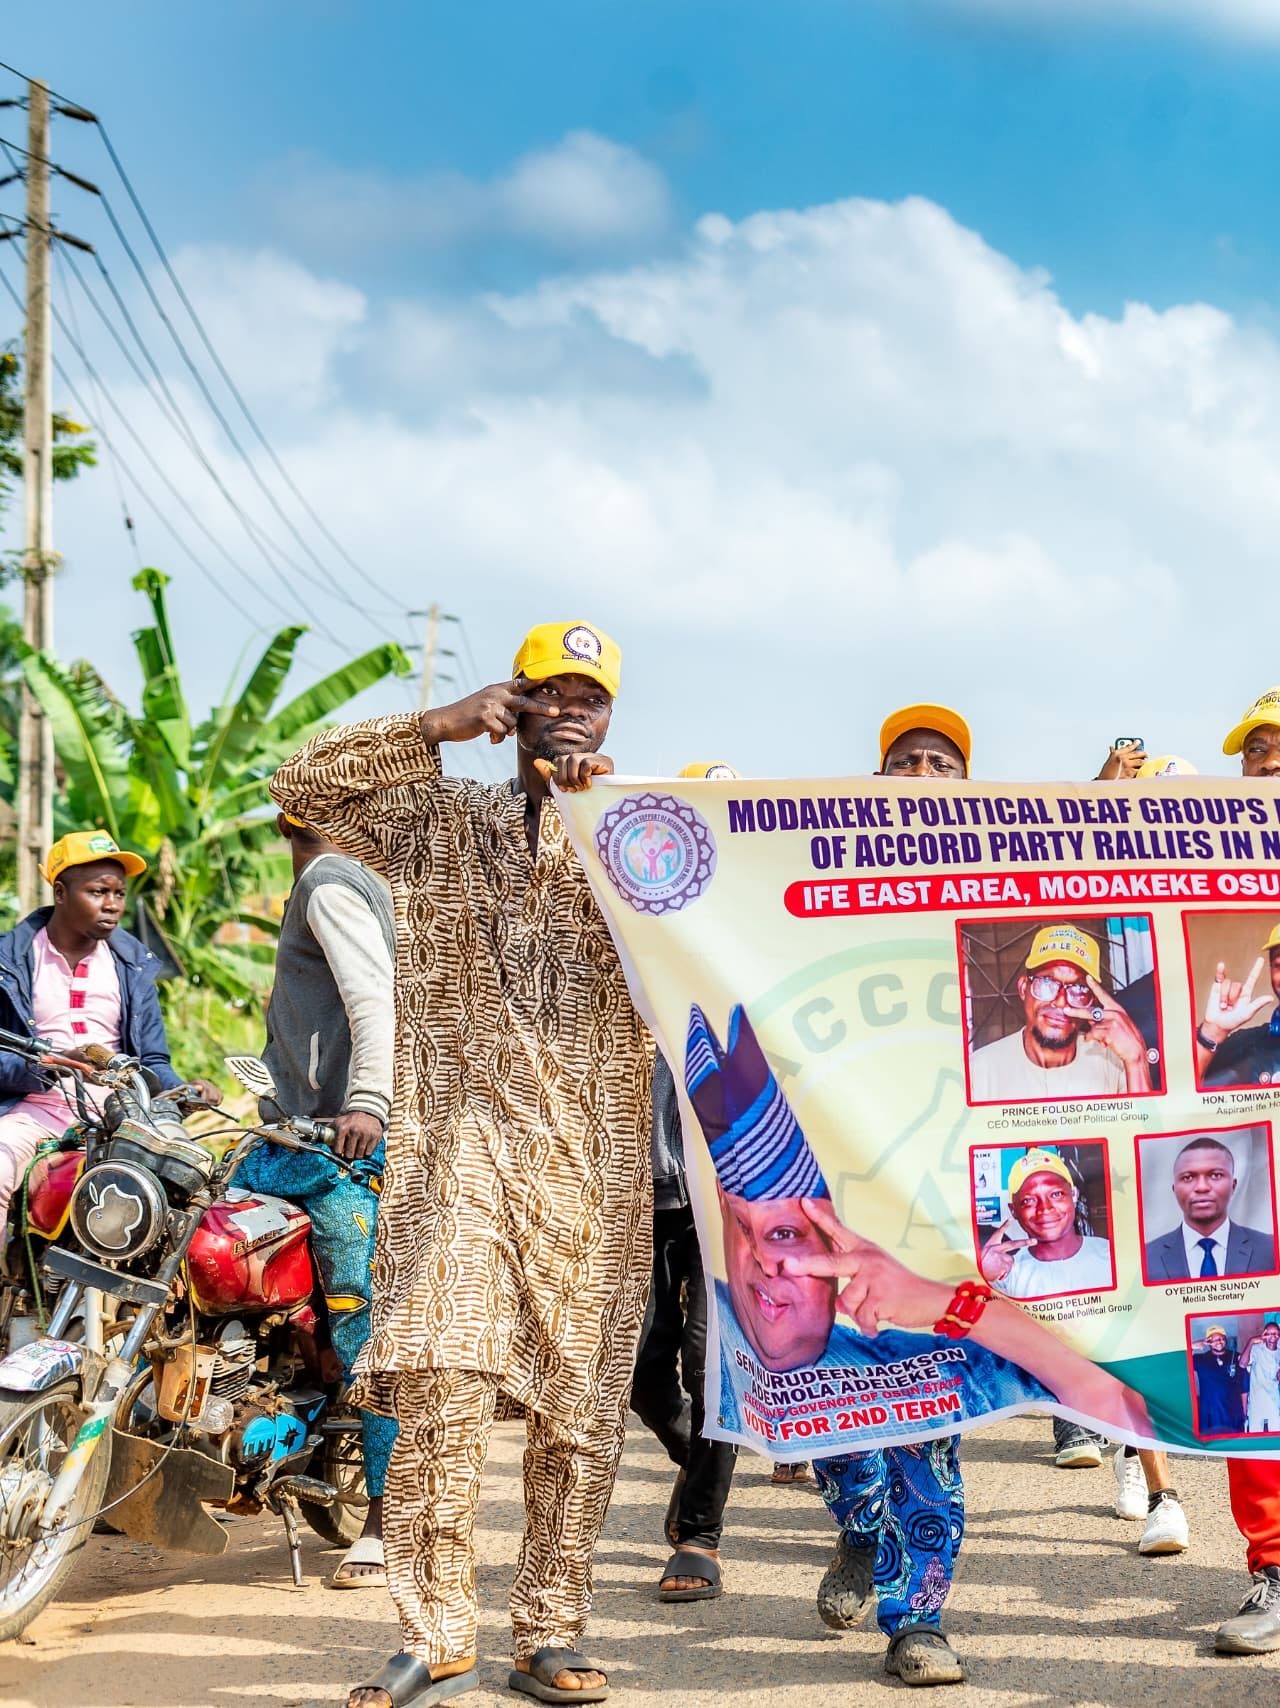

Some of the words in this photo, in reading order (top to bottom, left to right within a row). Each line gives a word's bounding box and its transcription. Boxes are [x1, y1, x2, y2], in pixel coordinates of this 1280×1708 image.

[727, 797, 894, 833] MODAKEKE
[897, 797, 1054, 827] POLITICAL
[1056, 798, 1132, 824] DEAF
[1138, 797, 1268, 825] GROUPS
[810, 836, 847, 870] OF
[855, 832, 982, 868] ACCORD
[988, 831, 1084, 862] PARTY
[1093, 830, 1214, 860] RALLIES
[1219, 831, 1254, 860] IN
[803, 884, 850, 910] IFE
[858, 881, 931, 907] EAST
[940, 879, 1031, 905] AREA,
[1039, 874, 1211, 900] MODAKEKE
[1202, 1096, 1227, 1105] HON.
[1230, 1092, 1271, 1103] TOMIWA
[1002, 1106, 1039, 1117] PRINCE
[1042, 1103, 1084, 1114] FOLUSO
[1086, 1102, 1133, 1112] ADEWUSI
[1216, 1105, 1254, 1116] Aspirant
[987, 1120, 1009, 1129] CEO
[1011, 1117, 1058, 1128] Modakeke
[1060, 1115, 1081, 1126] Deaf
[1083, 1113, 1118, 1124] Political
[1120, 1112, 1149, 1123] Group
[1165, 1285, 1217, 1296] OYEDIRAN
[1220, 1281, 1261, 1292] SUNDAY
[1183, 1295, 1206, 1304] Media
[1207, 1292, 1245, 1303] Secretary
[1032, 1301, 1063, 1312] SODIQ
[1066, 1296, 1102, 1307] PELUMI
[1039, 1313, 1056, 1322] Mdk
[1057, 1311, 1075, 1321] Deaf
[1077, 1307, 1106, 1319] Political
[1108, 1303, 1133, 1314] Group
[736, 1350, 755, 1377] SEN
[757, 1366, 859, 1390] NURUDEEN
[866, 1348, 966, 1377] JACKSON
[752, 1380, 836, 1407] ADEMOLA
[841, 1366, 940, 1394] ADELEKE
[788, 1396, 857, 1417] GOVENOR
[861, 1392, 878, 1403] OF
[882, 1386, 920, 1399] OSUN
[923, 1376, 964, 1393] STATE
[743, 1406, 777, 1441] VOTE
[780, 1416, 831, 1441] FOR
[836, 1406, 887, 1431] 2ND
[892, 1393, 961, 1421] TERM
